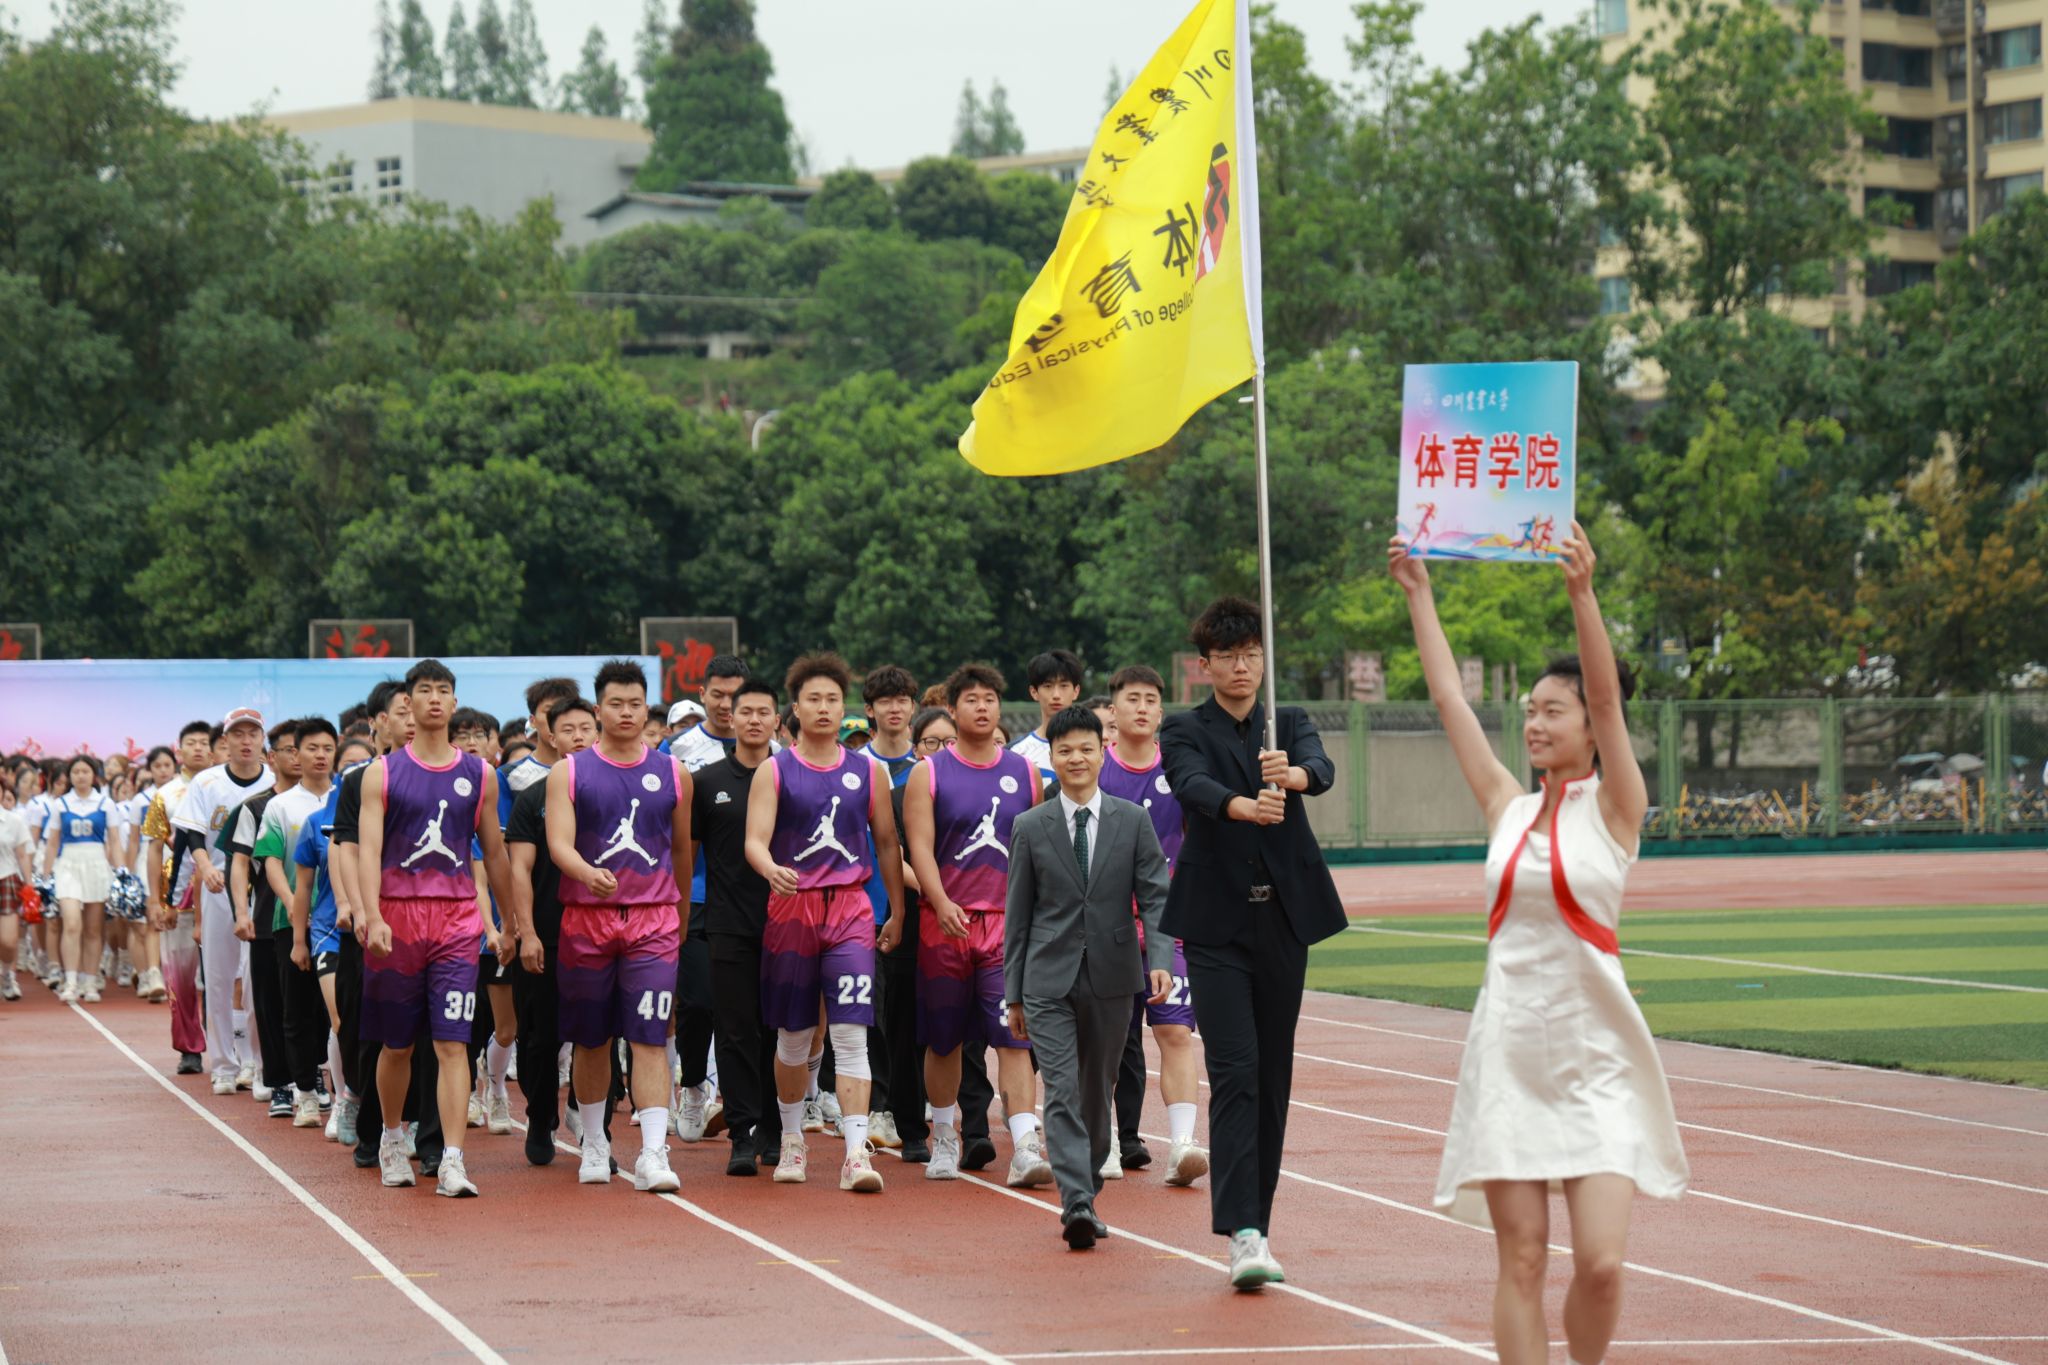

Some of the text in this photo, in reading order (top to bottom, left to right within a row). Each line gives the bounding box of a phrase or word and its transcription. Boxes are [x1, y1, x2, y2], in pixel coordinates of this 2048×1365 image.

[1415, 432, 1561, 489] 体育学院
[636, 990, 673, 1020] 40
[838, 974, 872, 1005] 22
[444, 990, 476, 1022] 30
